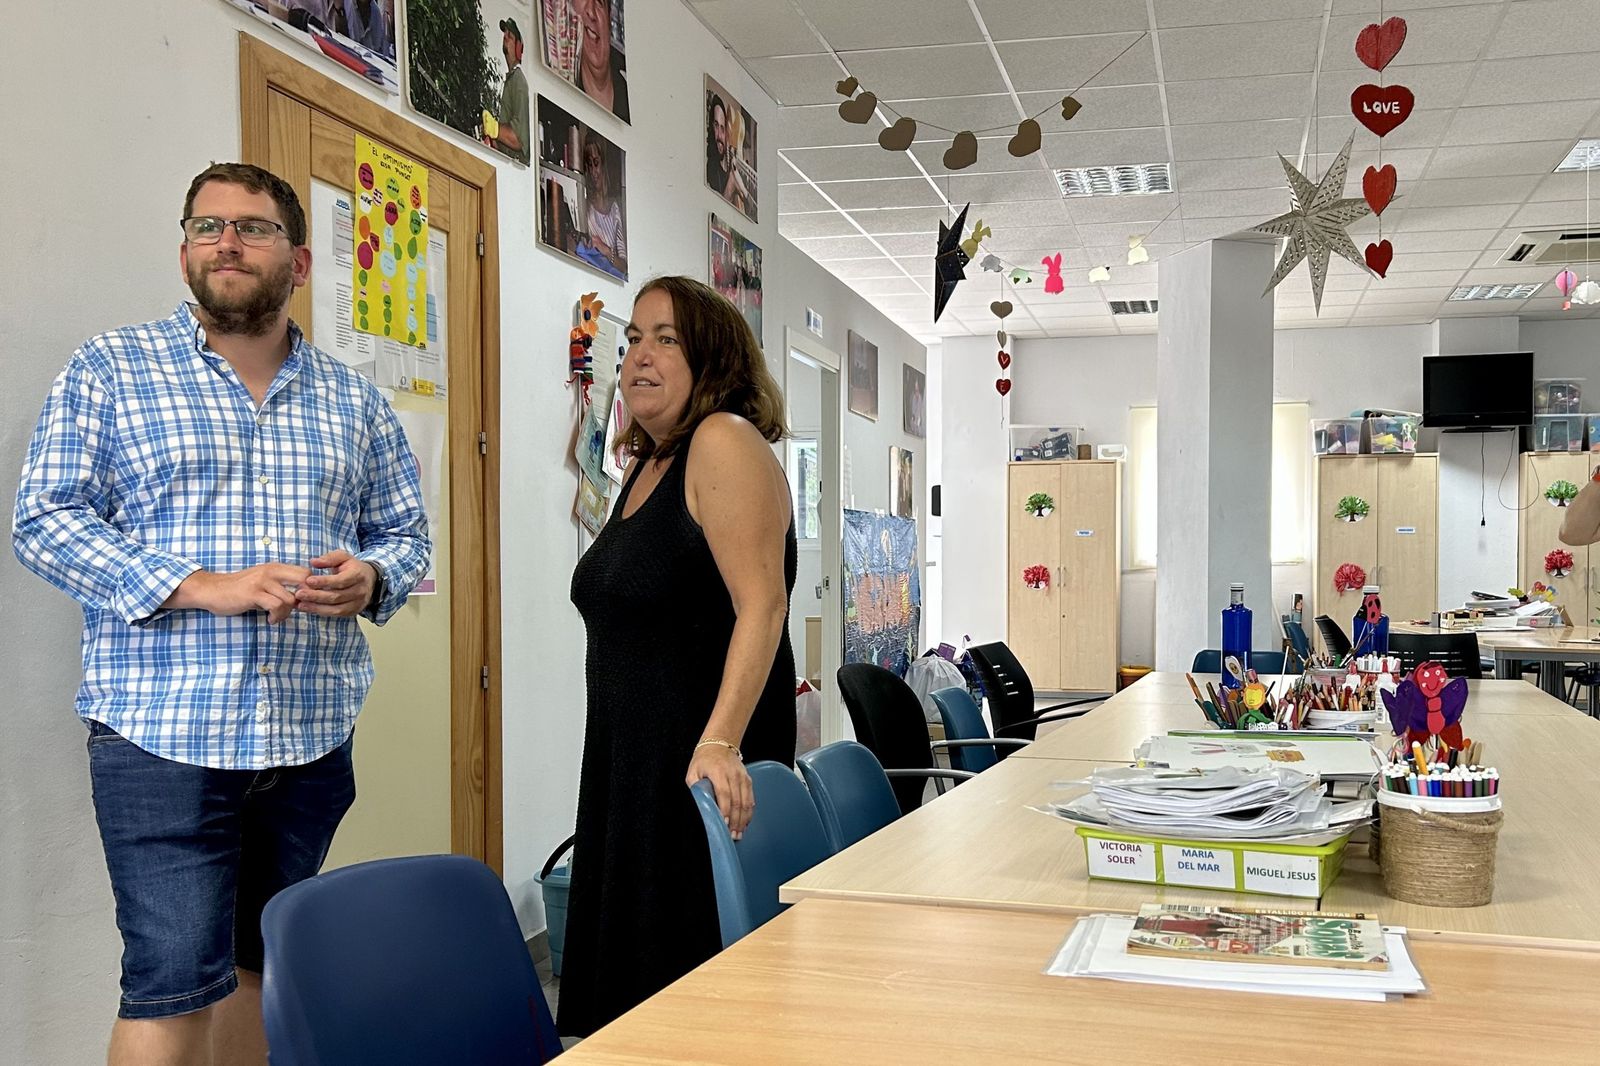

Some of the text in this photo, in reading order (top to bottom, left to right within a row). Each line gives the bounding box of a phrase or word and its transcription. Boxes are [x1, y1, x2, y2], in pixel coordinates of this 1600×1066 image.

[1362, 101, 1401, 114] LOVE
[1099, 841, 1142, 852] VICTORIA
[1107, 855, 1136, 864] SOLER
[1181, 849, 1214, 859] MARIA
[1177, 861, 1220, 872] DEL MAR
[1246, 866, 1316, 881] MIGUEL JESUS
